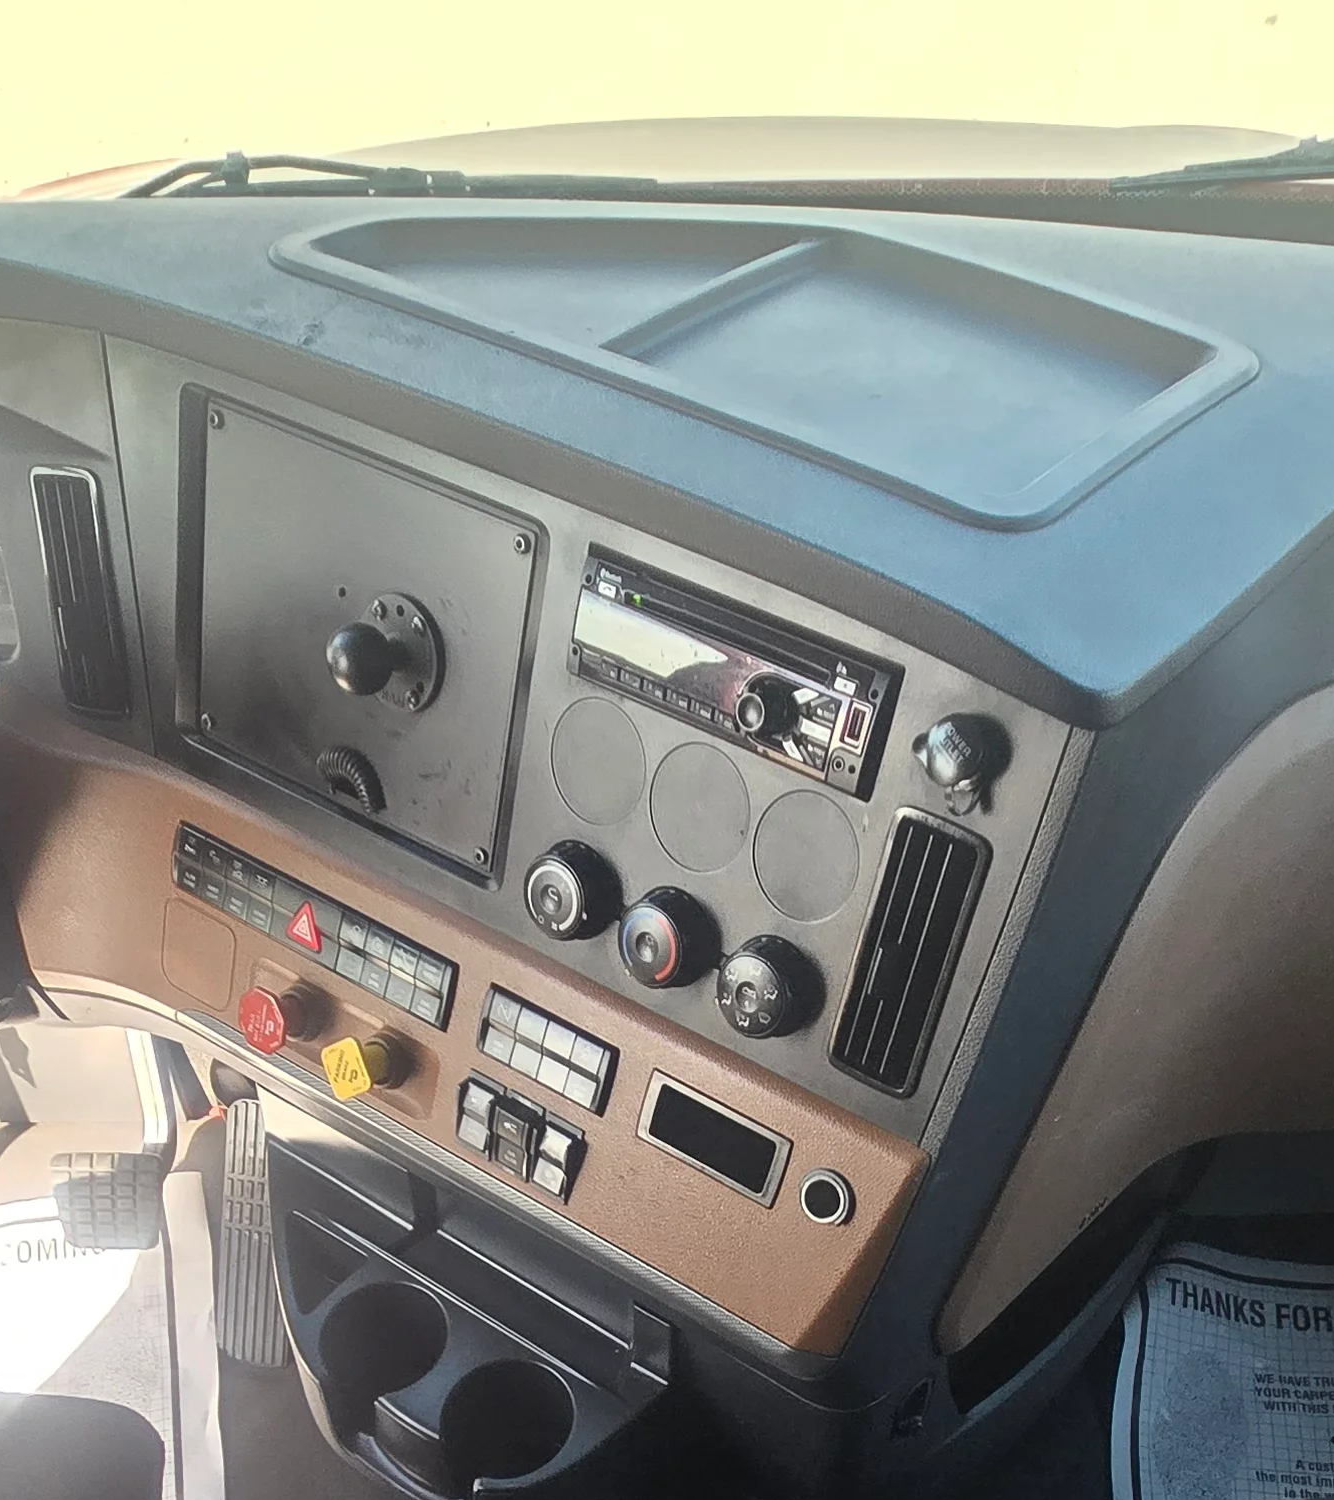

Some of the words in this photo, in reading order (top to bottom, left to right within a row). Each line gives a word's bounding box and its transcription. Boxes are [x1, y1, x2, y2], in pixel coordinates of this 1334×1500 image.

[1166, 1277, 1266, 1329] THANKS
[1275, 1303, 1333, 1332] FOR
[1254, 1373, 1274, 1384] WE
[1279, 1375, 1310, 1387] HAVE
[1254, 1386, 1291, 1399] YOUR
[1299, 1402, 1329, 1415] THIS
[1295, 1459, 1305, 1471] A
[1255, 1470, 1276, 1482] the
[1281, 1473, 1312, 1486] most
